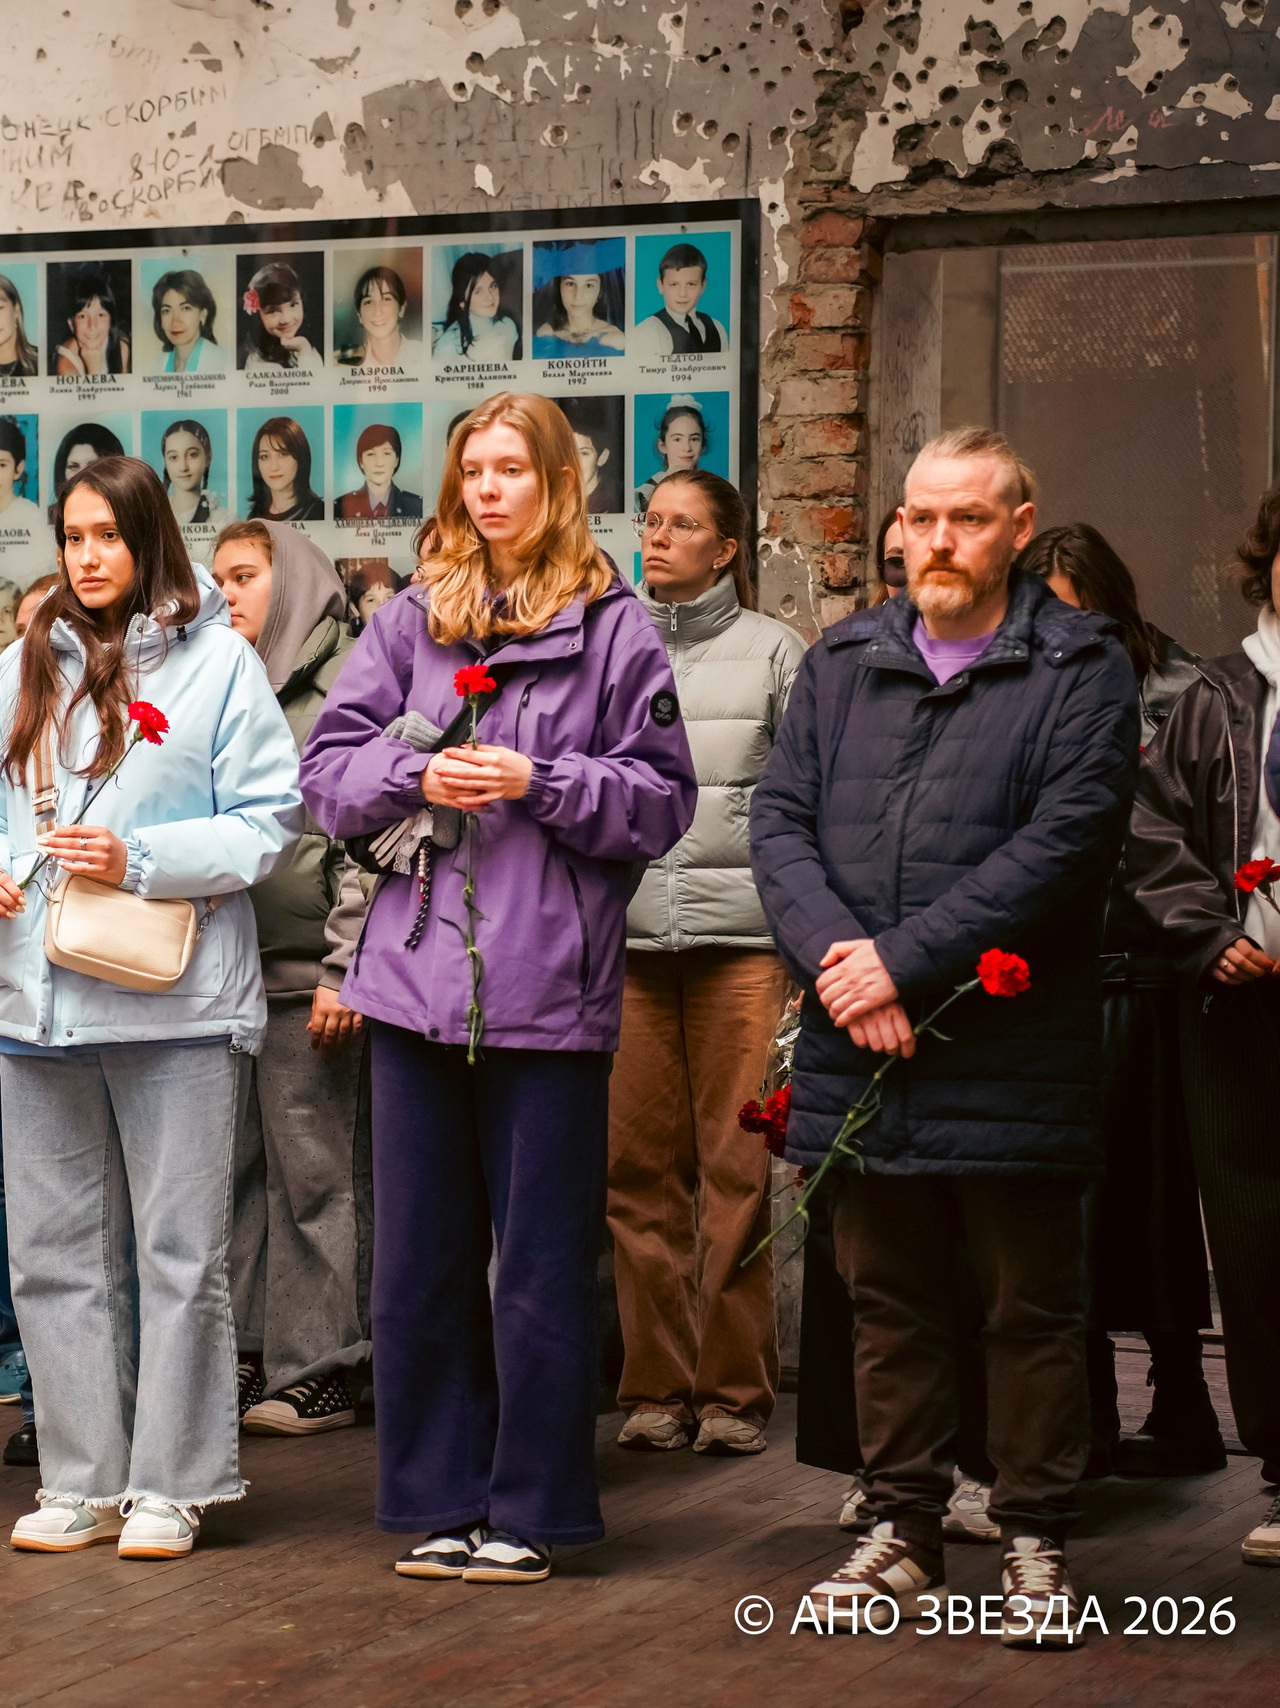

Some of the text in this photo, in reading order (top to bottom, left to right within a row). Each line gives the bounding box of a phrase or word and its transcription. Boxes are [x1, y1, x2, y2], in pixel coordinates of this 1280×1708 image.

[443, 363, 508, 373] ФАРНИЕВА
[548, 357, 607, 369] КОКОЙТИ
[350, 366, 405, 376] БАЗРОВА
[639, 363, 727, 374] Тимур Эльбрусович
[56, 374, 117, 385] НОГАЕВА
[435, 375, 475, 384] Кристина
[671, 374, 692, 382] 1994
